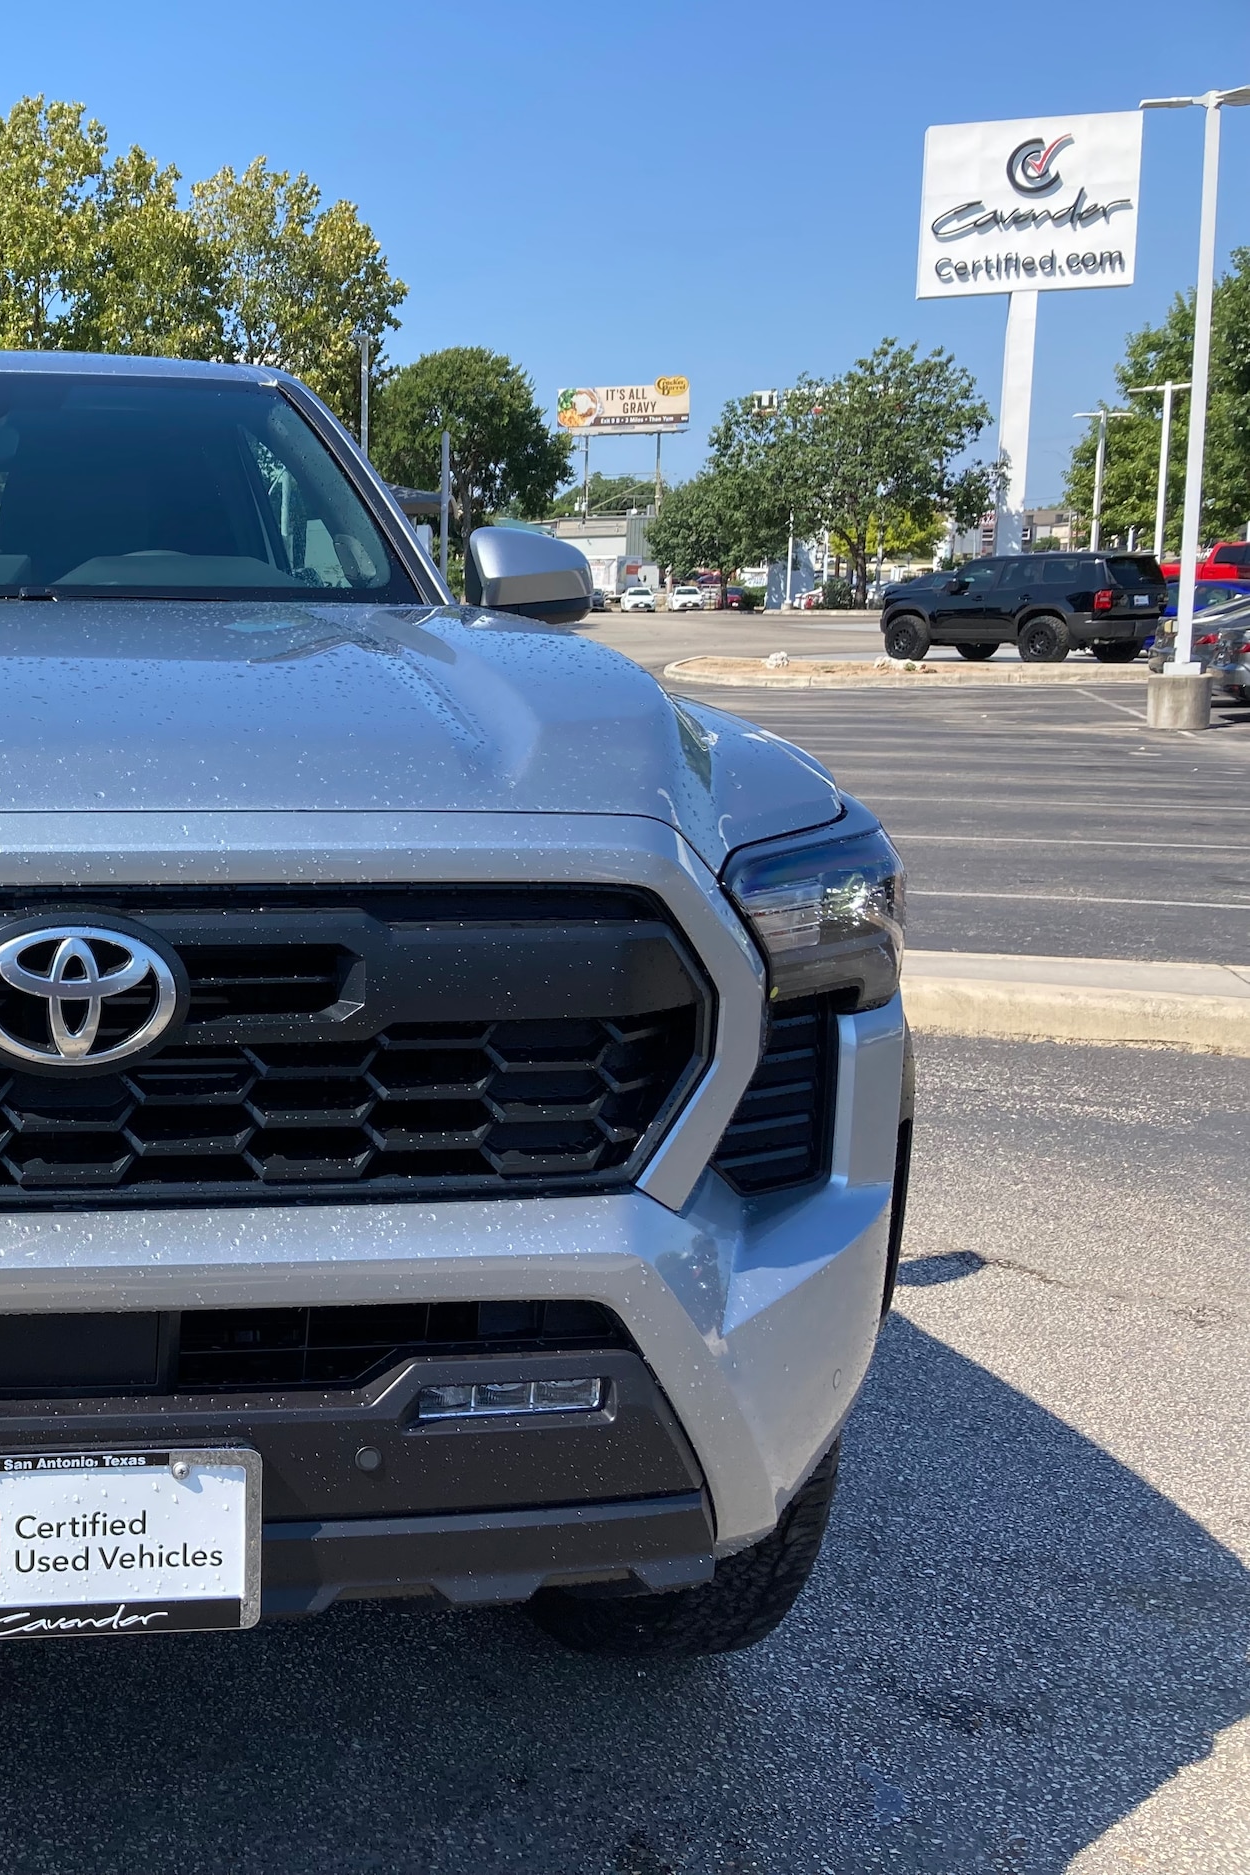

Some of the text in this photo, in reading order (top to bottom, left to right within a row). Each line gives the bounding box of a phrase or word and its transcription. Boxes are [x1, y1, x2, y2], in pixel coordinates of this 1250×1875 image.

[932, 187, 1132, 236] Cavender
[935, 249, 1124, 278] Certified.com
[657, 377, 684, 390] Cracker
[662, 384, 686, 396] Barrel
[606, 387, 647, 401] IT'S ALL
[622, 401, 657, 414] GRAVY
[3, 1454, 146, 1471] San Antonio, Texas
[14, 1510, 148, 1540] Certified
[14, 1542, 224, 1573] Used Vehicles
